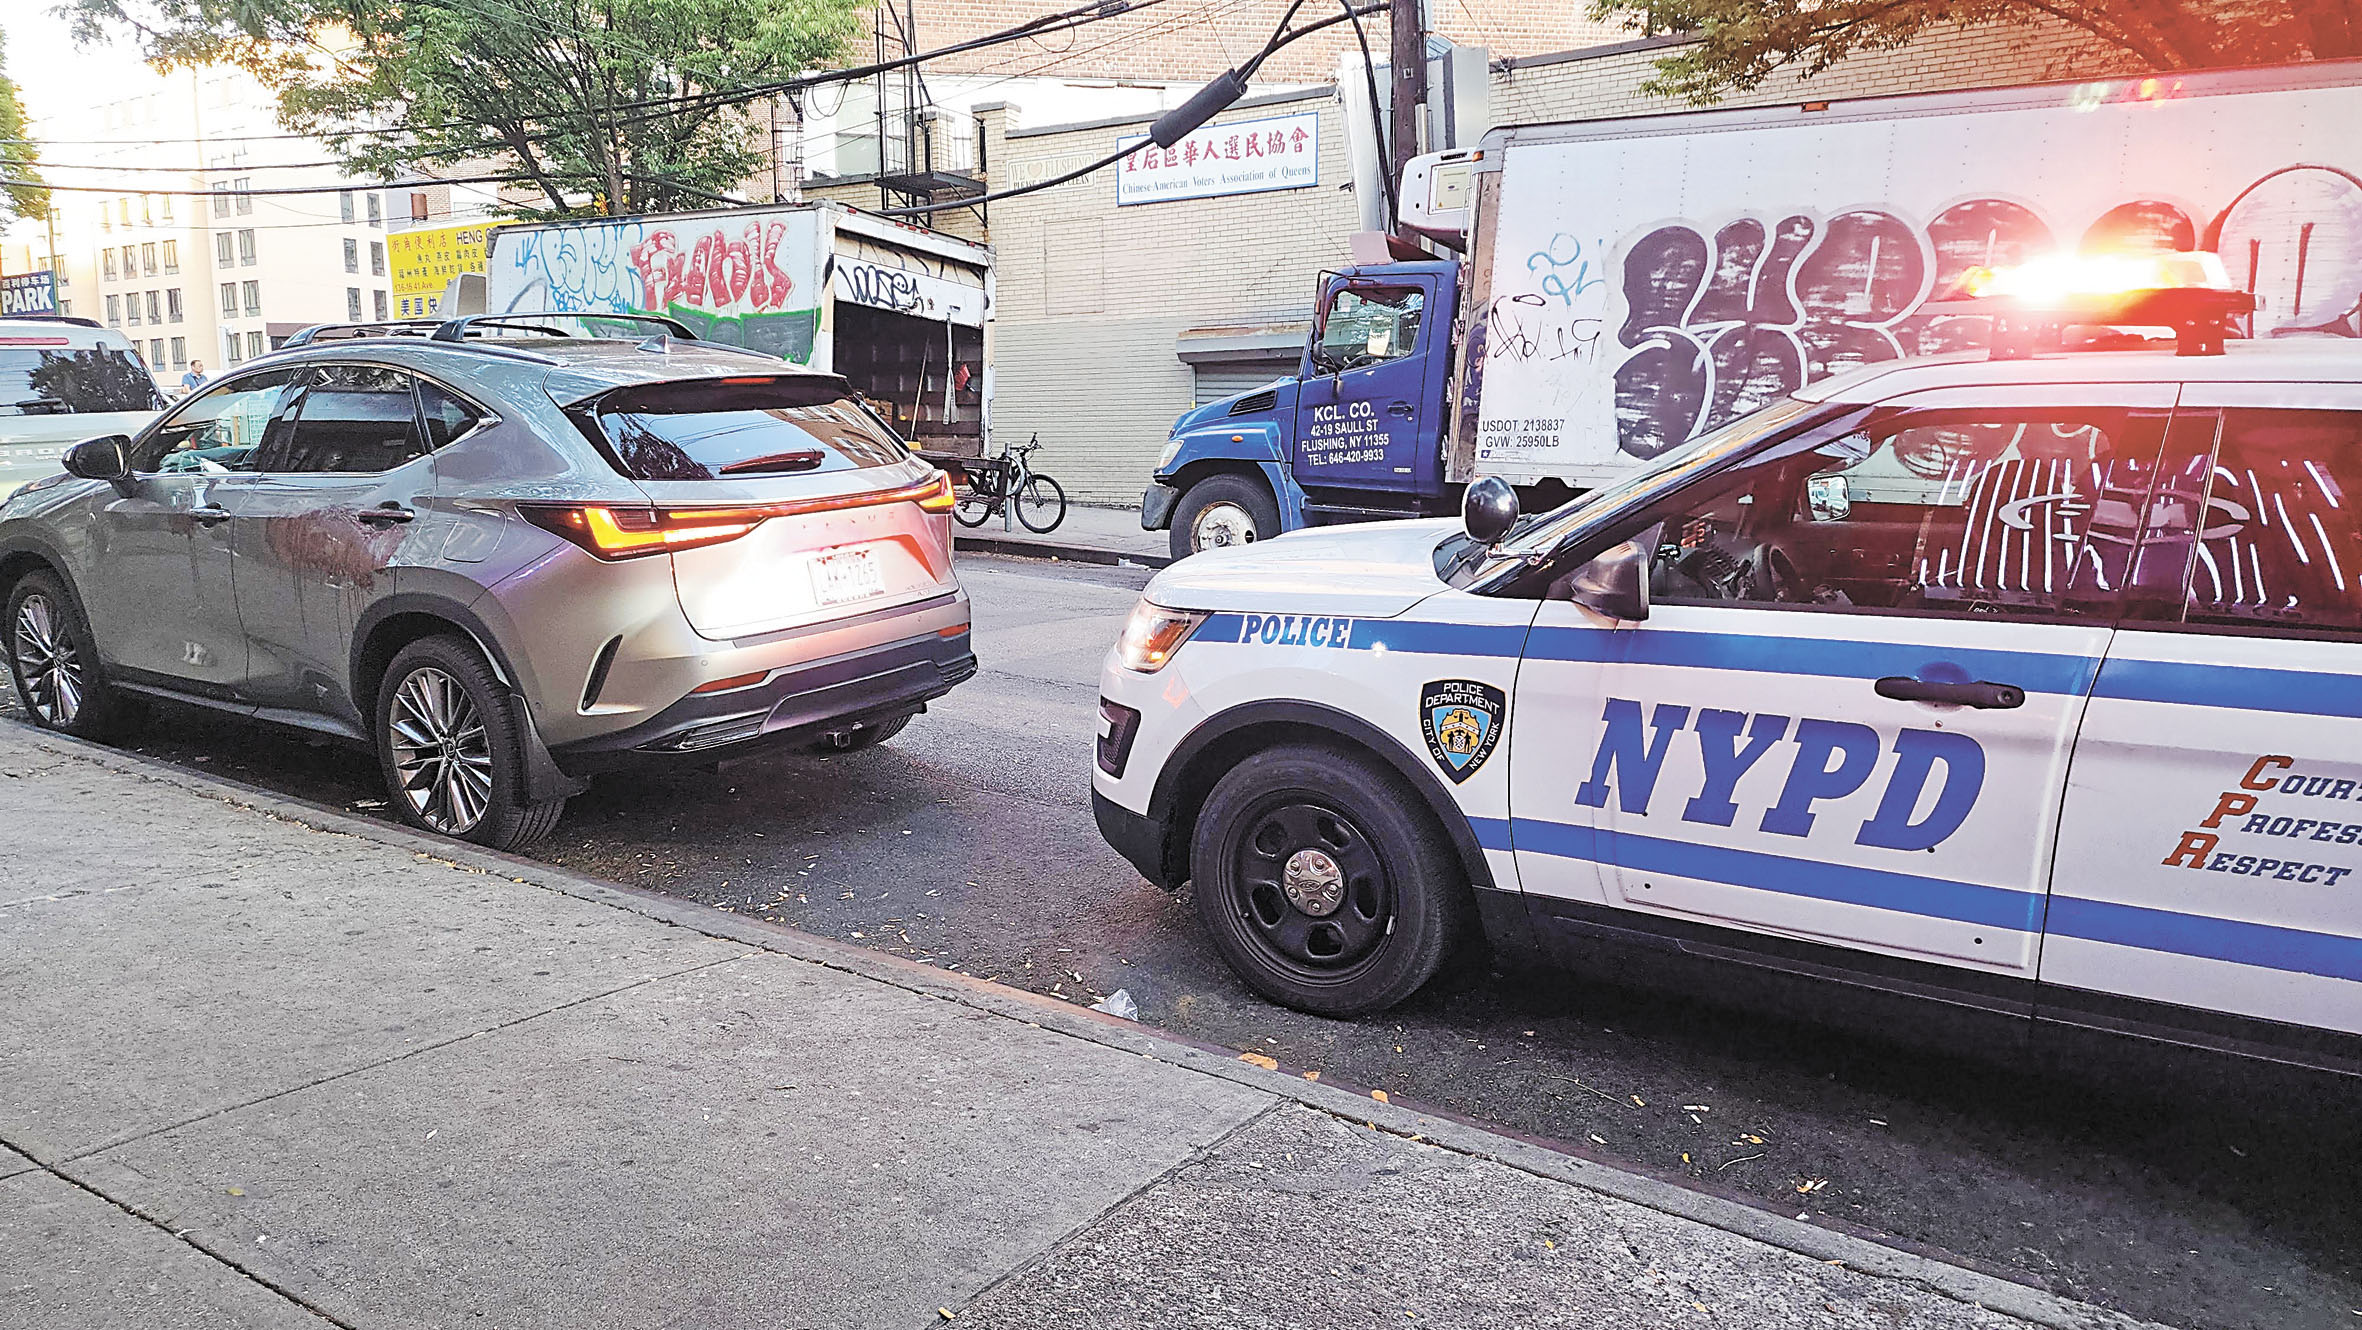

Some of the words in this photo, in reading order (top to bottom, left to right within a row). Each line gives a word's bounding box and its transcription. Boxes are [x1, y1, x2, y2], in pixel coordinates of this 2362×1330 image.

[1124, 126, 1310, 174] 皇后區華人選民協會
[1193, 176, 1215, 187] Voters
[1219, 170, 1264, 185] Association
[1268, 167, 1277, 179] of
[1281, 165, 1311, 179] Queens
[456, 229, 483, 246] HENG
[1, 285, 54, 314] PARK
[1314, 405, 1346, 422] KCL.
[1349, 401, 1375, 418] CO.
[1310, 423, 1333, 437] 42-19
[1334, 420, 1365, 435] SAULL
[1366, 418, 1379, 432] ST
[1523, 418, 1565, 432] 2138837
[1301, 436, 1348, 453] FLUSHING,
[1349, 434, 1363, 448] NY
[1364, 433, 1390, 447] 11355
[1485, 435, 1513, 448] GVW:
[1516, 435, 1560, 448] 25950LB
[1307, 453, 1328, 467] TEL:
[1328, 448, 1384, 465] 646-420-9933
[1241, 614, 1350, 649] POLICE
[1443, 682, 1484, 697] POLICE
[1425, 692, 1500, 715] DEPARTMENT
[1423, 719, 1437, 745] CITY
[1432, 747, 1445, 761] OF
[1468, 748, 1488, 770] NEW
[1484, 722, 1500, 747] YORK
[1574, 697, 1986, 852] NYPD
[2199, 791, 2362, 846] PROFES
[2161, 830, 2352, 886] RESPECT
